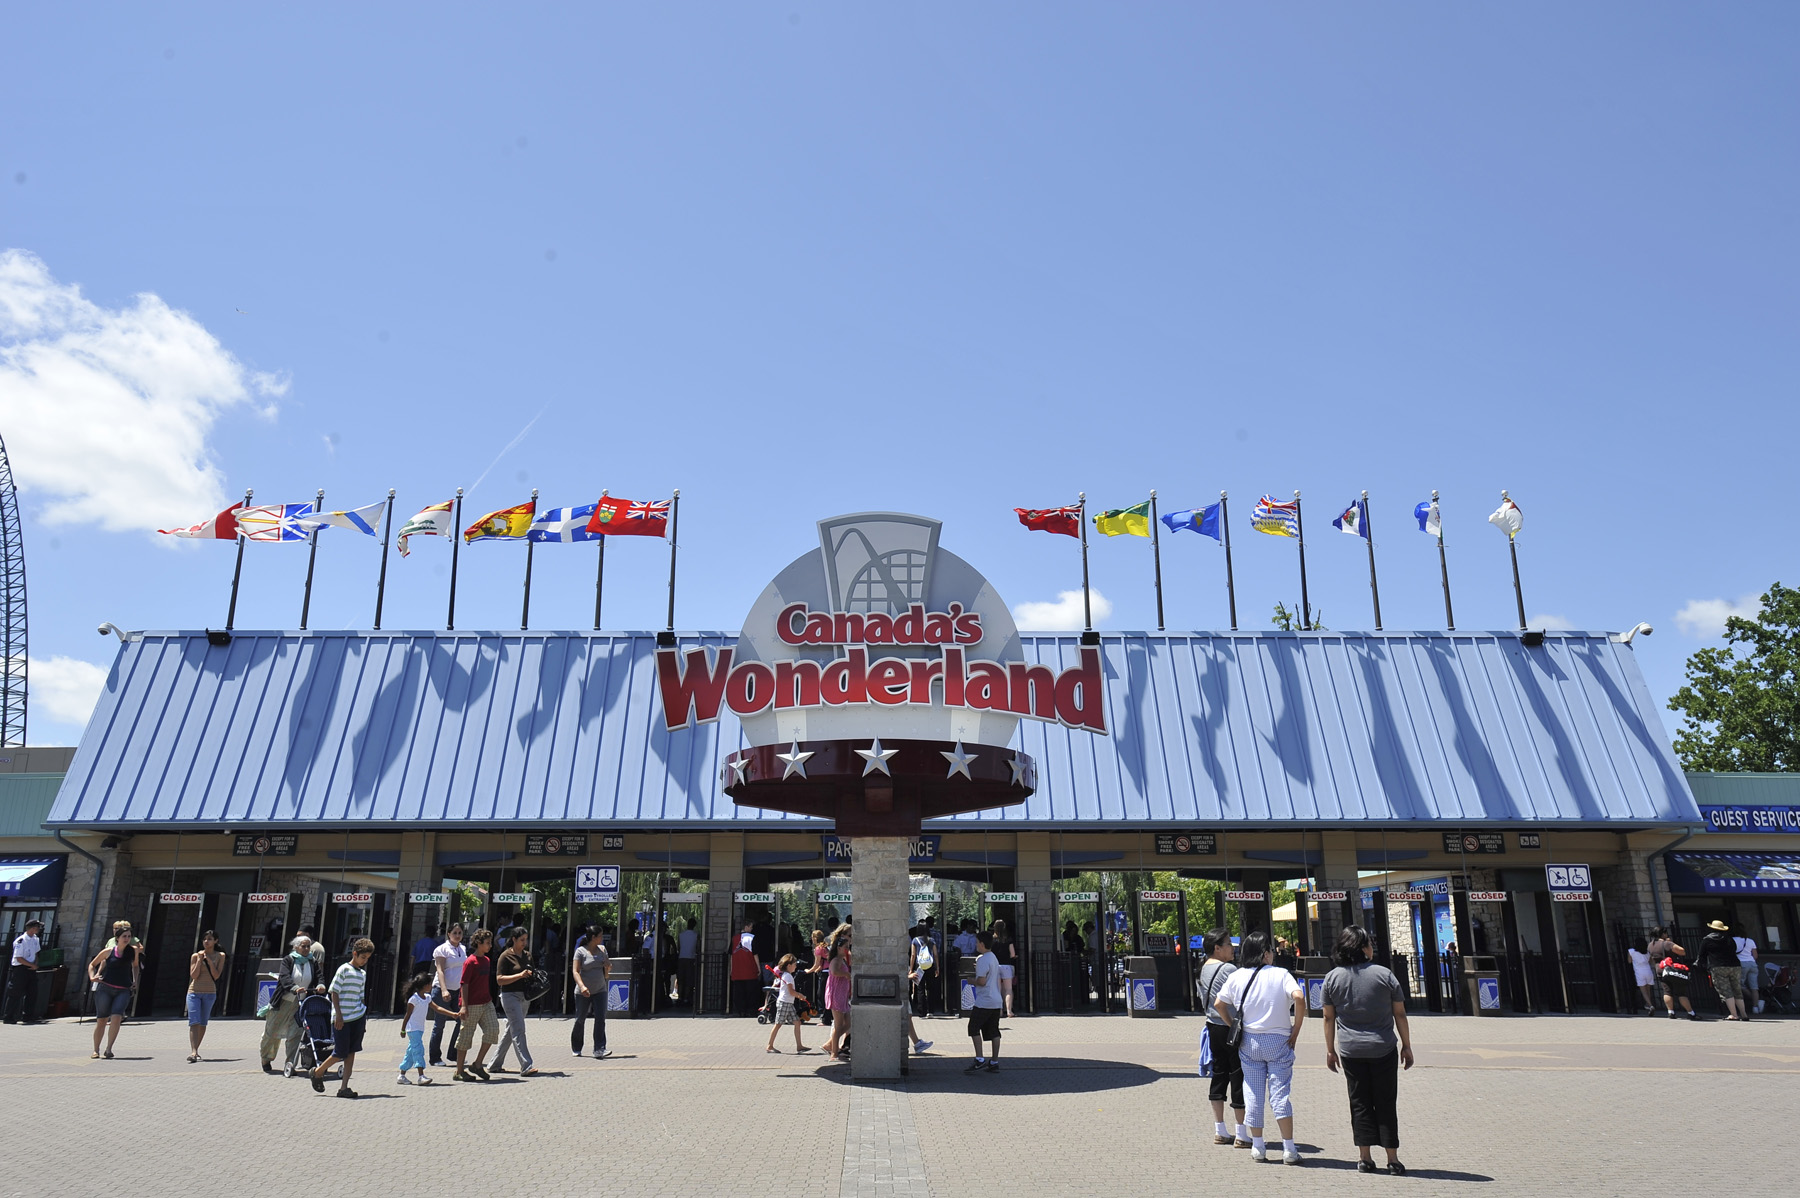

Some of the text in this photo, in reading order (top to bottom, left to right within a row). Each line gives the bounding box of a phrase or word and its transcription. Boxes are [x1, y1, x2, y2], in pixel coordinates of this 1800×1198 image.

[776, 600, 984, 646] Canada's
[653, 644, 1109, 736] Wonderland
[1711, 810, 1800, 827] GUEST SERVICE
[827, 841, 852, 857] PAR
[163, 894, 198, 902] CLOSED
[250, 894, 284, 902] CLOSED
[415, 894, 443, 902] OPEN
[498, 894, 526, 902] OPEN
[1143, 892, 1177, 900] CLOSED
[1311, 892, 1344, 900] CLOSED
